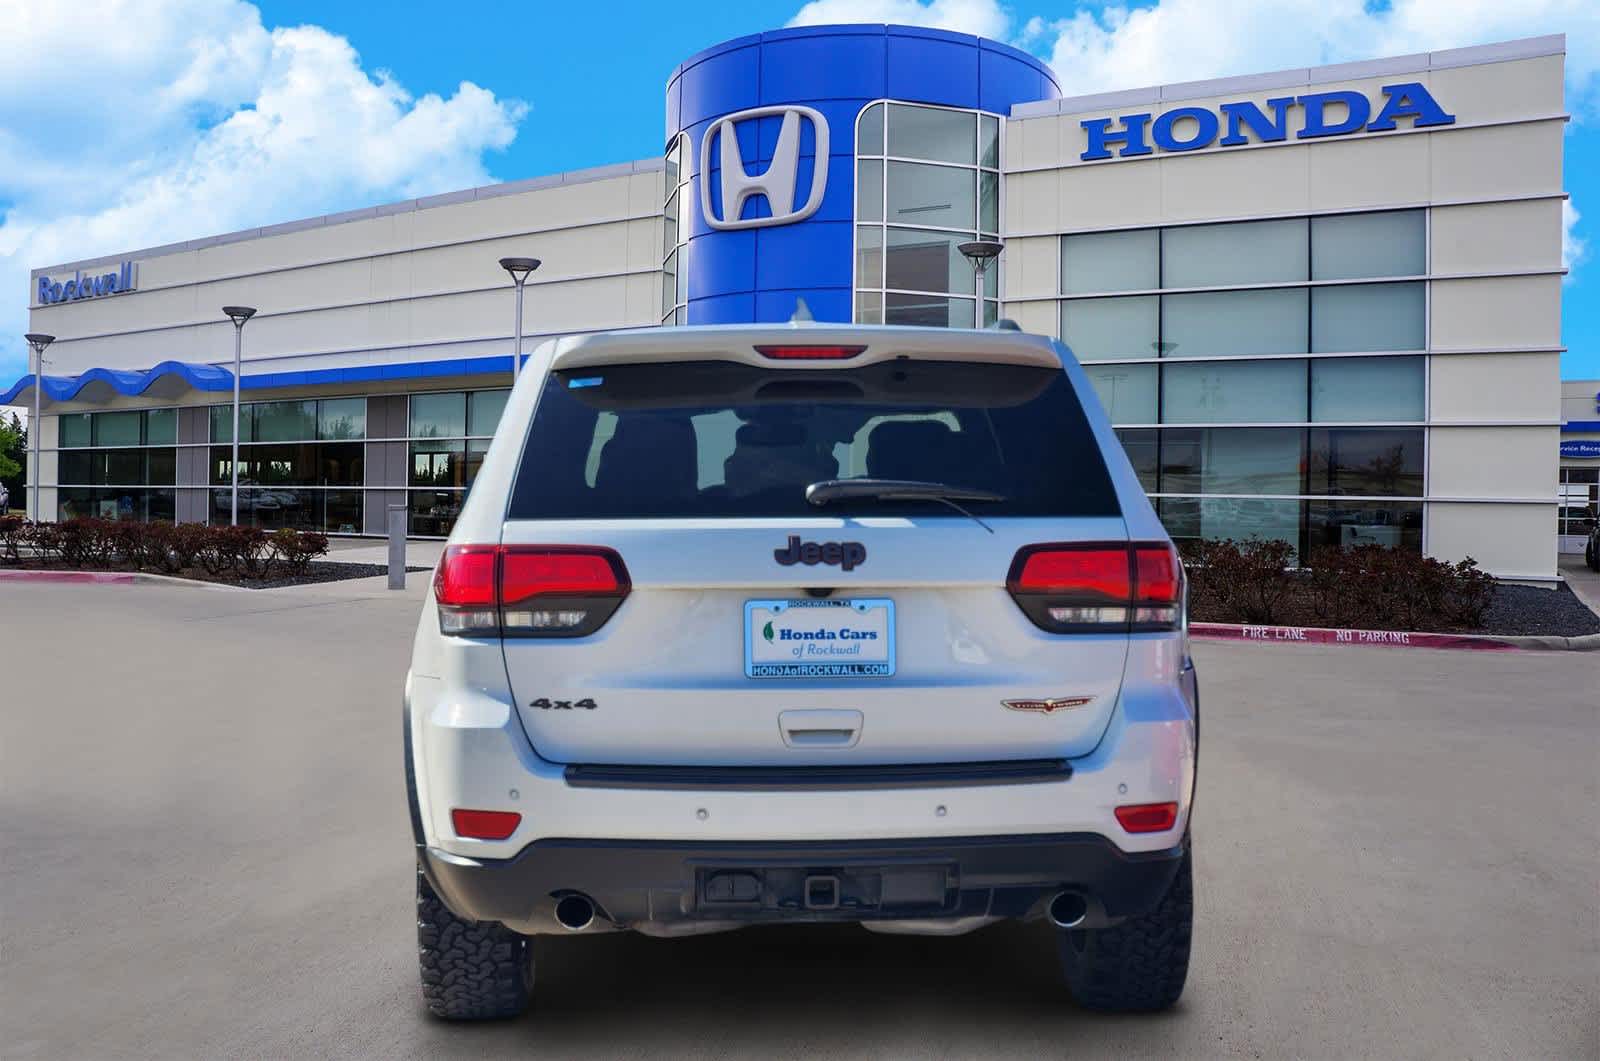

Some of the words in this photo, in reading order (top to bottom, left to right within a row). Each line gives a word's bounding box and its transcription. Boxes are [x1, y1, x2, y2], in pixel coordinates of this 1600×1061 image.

[1080, 82, 1455, 161] HONDA
[38, 261, 132, 304] Rockwall
[774, 536, 867, 572] Jeep
[779, 629, 836, 641] Honda
[839, 629, 878, 640] Cars
[1242, 626, 1269, 639] FIRE
[1275, 628, 1308, 640] LANE
[1336, 630, 1352, 642] NO
[1359, 631, 1409, 644] PARKING
[792, 643, 804, 658] of
[807, 643, 861, 655] Rockwall
[529, 698, 598, 710] 4x4
